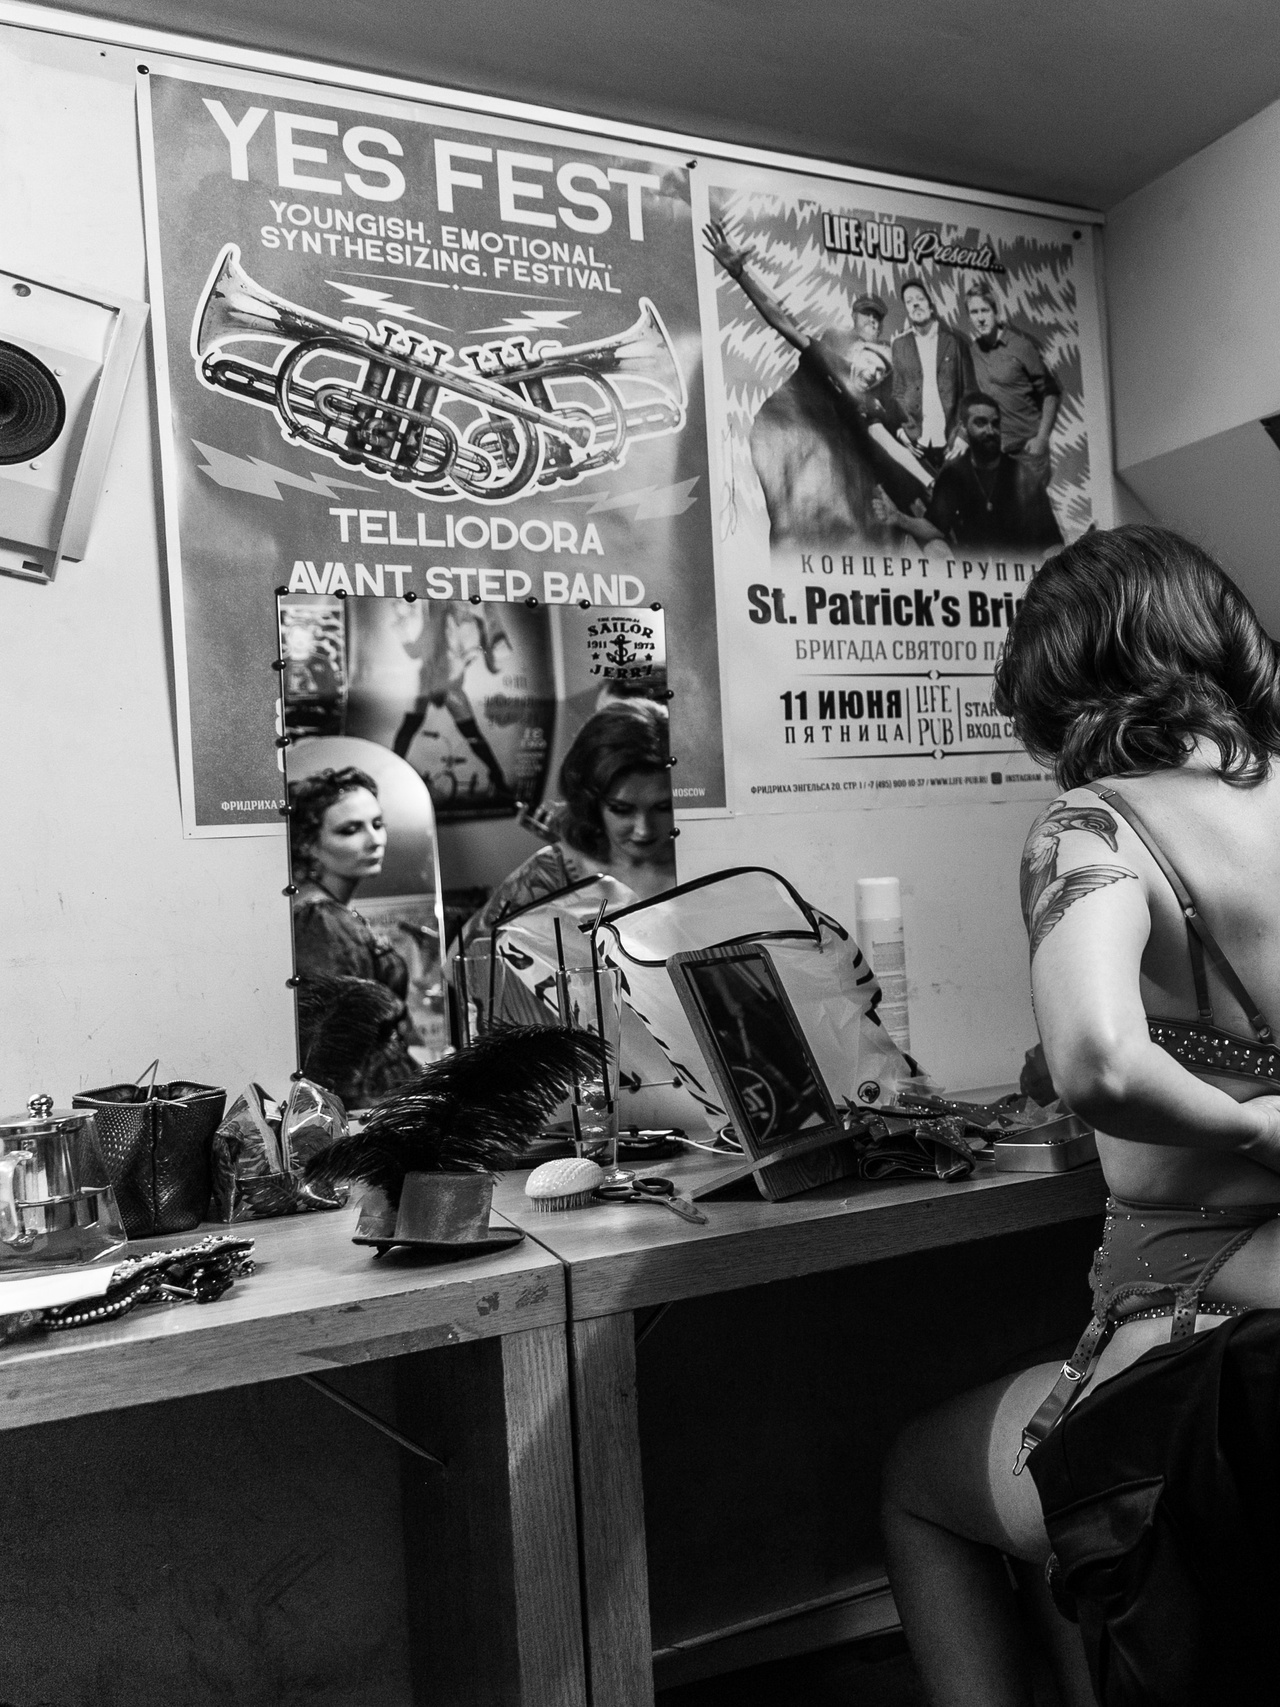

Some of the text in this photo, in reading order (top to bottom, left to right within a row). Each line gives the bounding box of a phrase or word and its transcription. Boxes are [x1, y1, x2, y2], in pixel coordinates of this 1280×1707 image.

[201, 97, 661, 242] YES FEST
[268, 199, 613, 270] YOUNGISH. EMOTIONAL.
[822, 212, 861, 255] LIFE
[865, 220, 907, 261] PUB
[260, 225, 622, 294] SYNTHESIZING. FESTIVAL
[329, 507, 605, 555] TELLIODORA
[801, 554, 929, 578] КОНЦЕРТ
[288, 561, 645, 606] AVANT STEP BAND
[747, 583, 797, 625] St.
[805, 586, 961, 627] Patrick's
[587, 622, 654, 638] SAILOR
[587, 640, 607, 649] 1911
[795, 639, 891, 662] БРИГАДА
[892, 640, 977, 661] СВЯТОГО
[589, 664, 653, 679] JERRY
[779, 690, 902, 721] 11 ИЮНЯ
[915, 684, 952, 714] LIFE
[965, 701, 1002, 718] STAR
[784, 724, 904, 744] ПЯТНИЦА
[917, 717, 954, 746] PUB
[966, 722, 1002, 740] ВХОД
[750, 784, 792, 794] ФРИДРИХА
[221, 800, 279, 811] ФРИДРИХА
